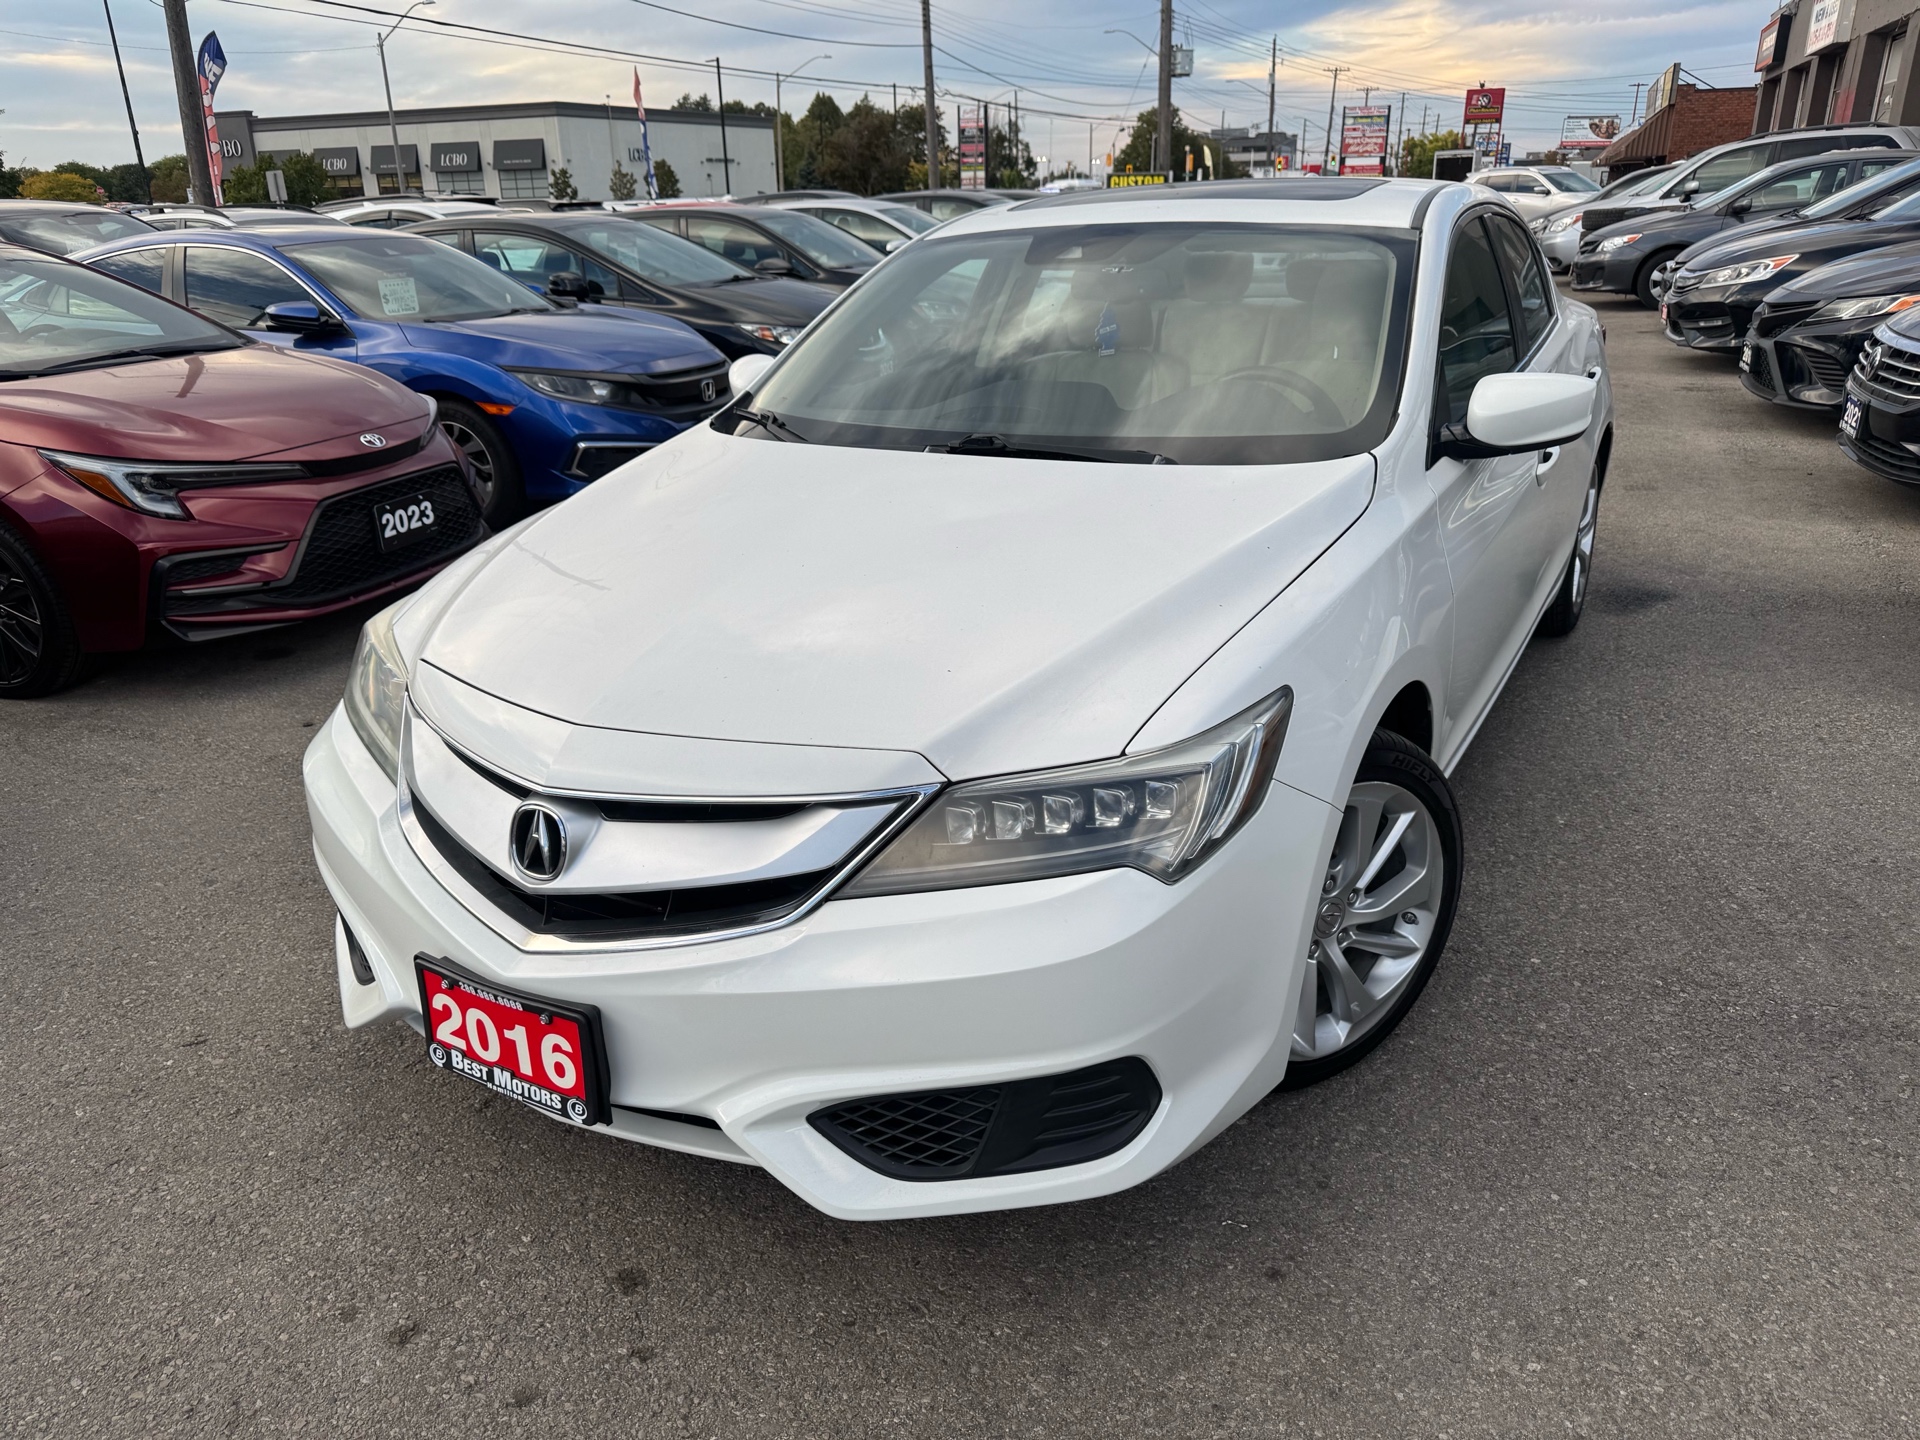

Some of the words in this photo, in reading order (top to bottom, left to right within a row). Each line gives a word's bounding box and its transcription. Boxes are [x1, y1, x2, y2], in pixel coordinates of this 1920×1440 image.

[322, 158, 347, 170] LCBO
[440, 153, 467, 166] LCBO
[1110, 175, 1165, 188] CUSTOM
[381, 500, 435, 539] 2023
[1391, 754, 1439, 783] HIFLY
[432, 993, 576, 1089] 2016
[451, 1049, 488, 1081] BEST
[493, 1066, 562, 1110] MOTORS
[486, 1082, 523, 1101] Hamilton
